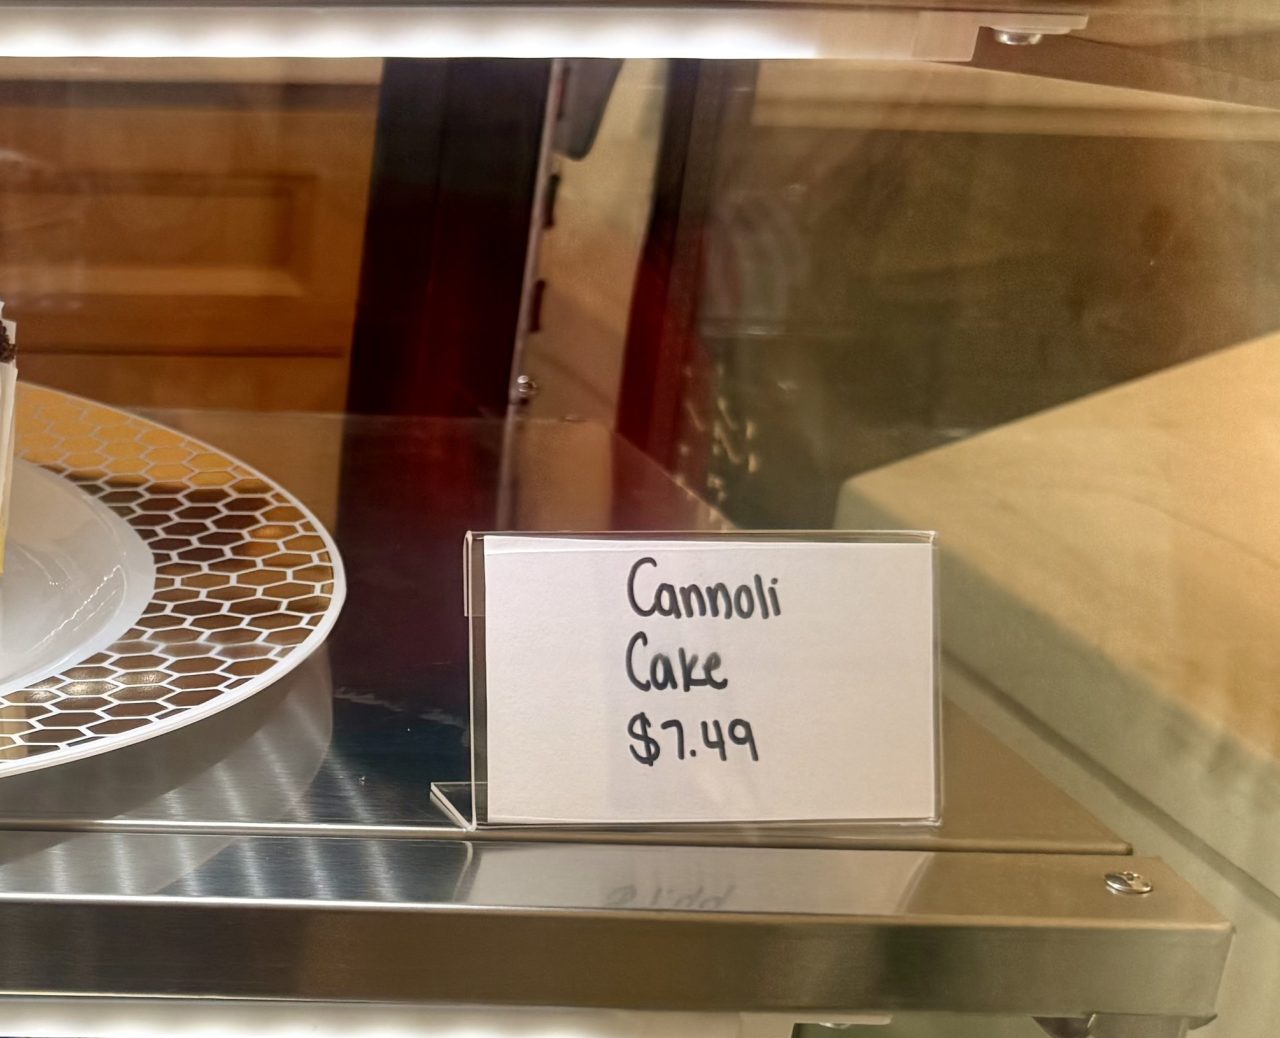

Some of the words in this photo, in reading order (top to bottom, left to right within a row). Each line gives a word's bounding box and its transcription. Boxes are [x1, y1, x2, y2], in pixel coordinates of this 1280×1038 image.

[627, 557, 781, 619] Cannoli
[626, 631, 728, 692] Cake
[627, 712, 759, 766] $7.49
